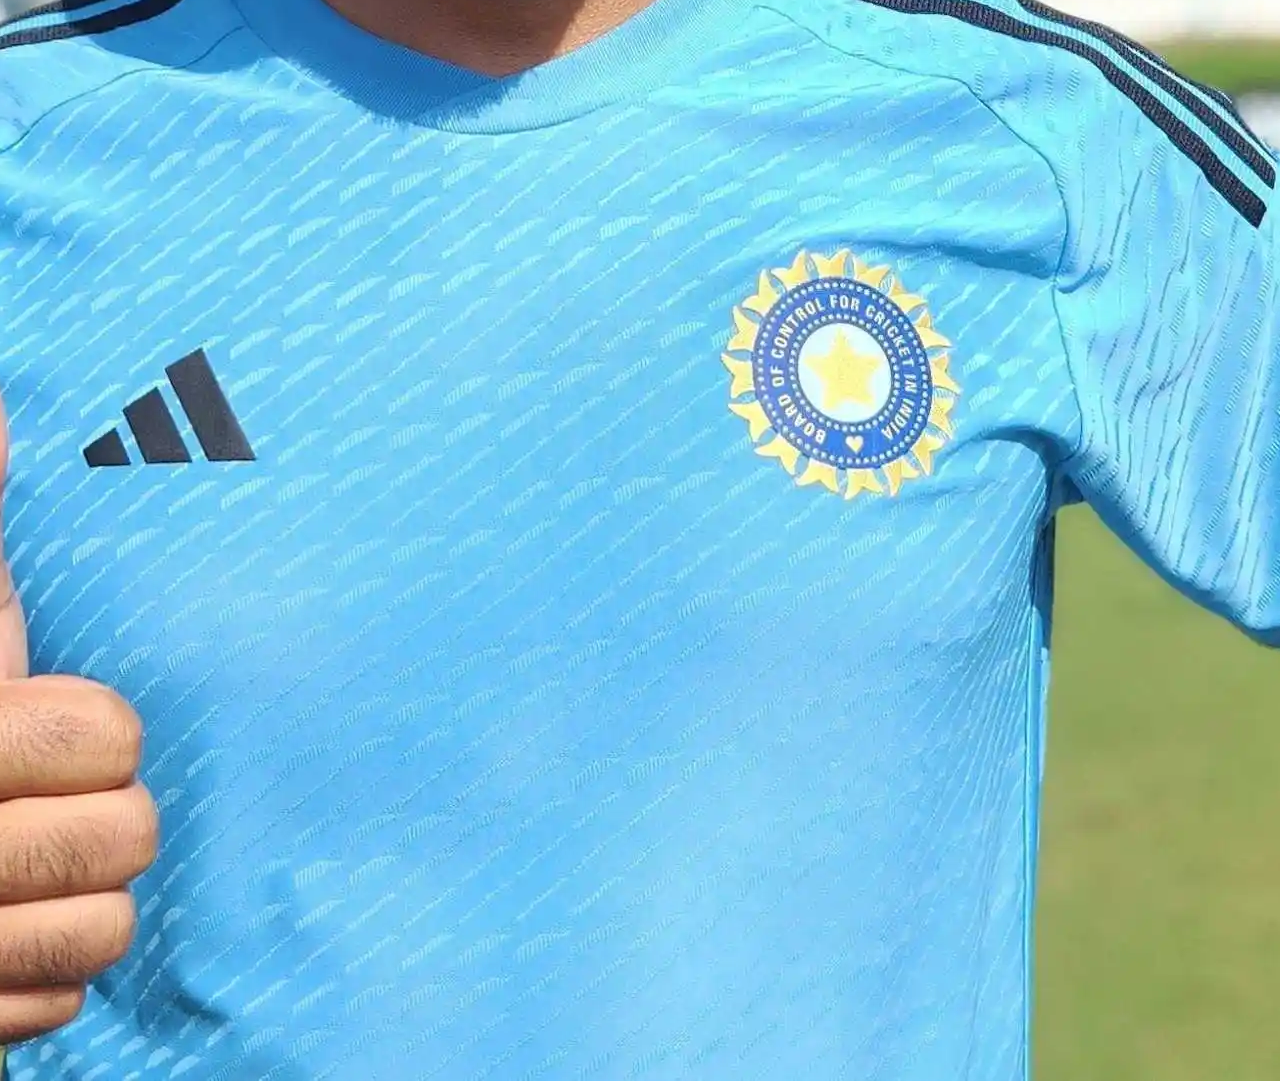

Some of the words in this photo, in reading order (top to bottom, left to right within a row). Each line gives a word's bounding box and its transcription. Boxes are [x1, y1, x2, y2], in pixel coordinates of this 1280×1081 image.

[829, 294, 860, 312] FOR
[771, 298, 825, 358] CONTROL
[865, 304, 914, 367] CRICKET
[770, 365, 784, 387] OF
[903, 373, 917, 394] IN
[778, 394, 826, 445] BOARD
[881, 398, 915, 440] INDIA
